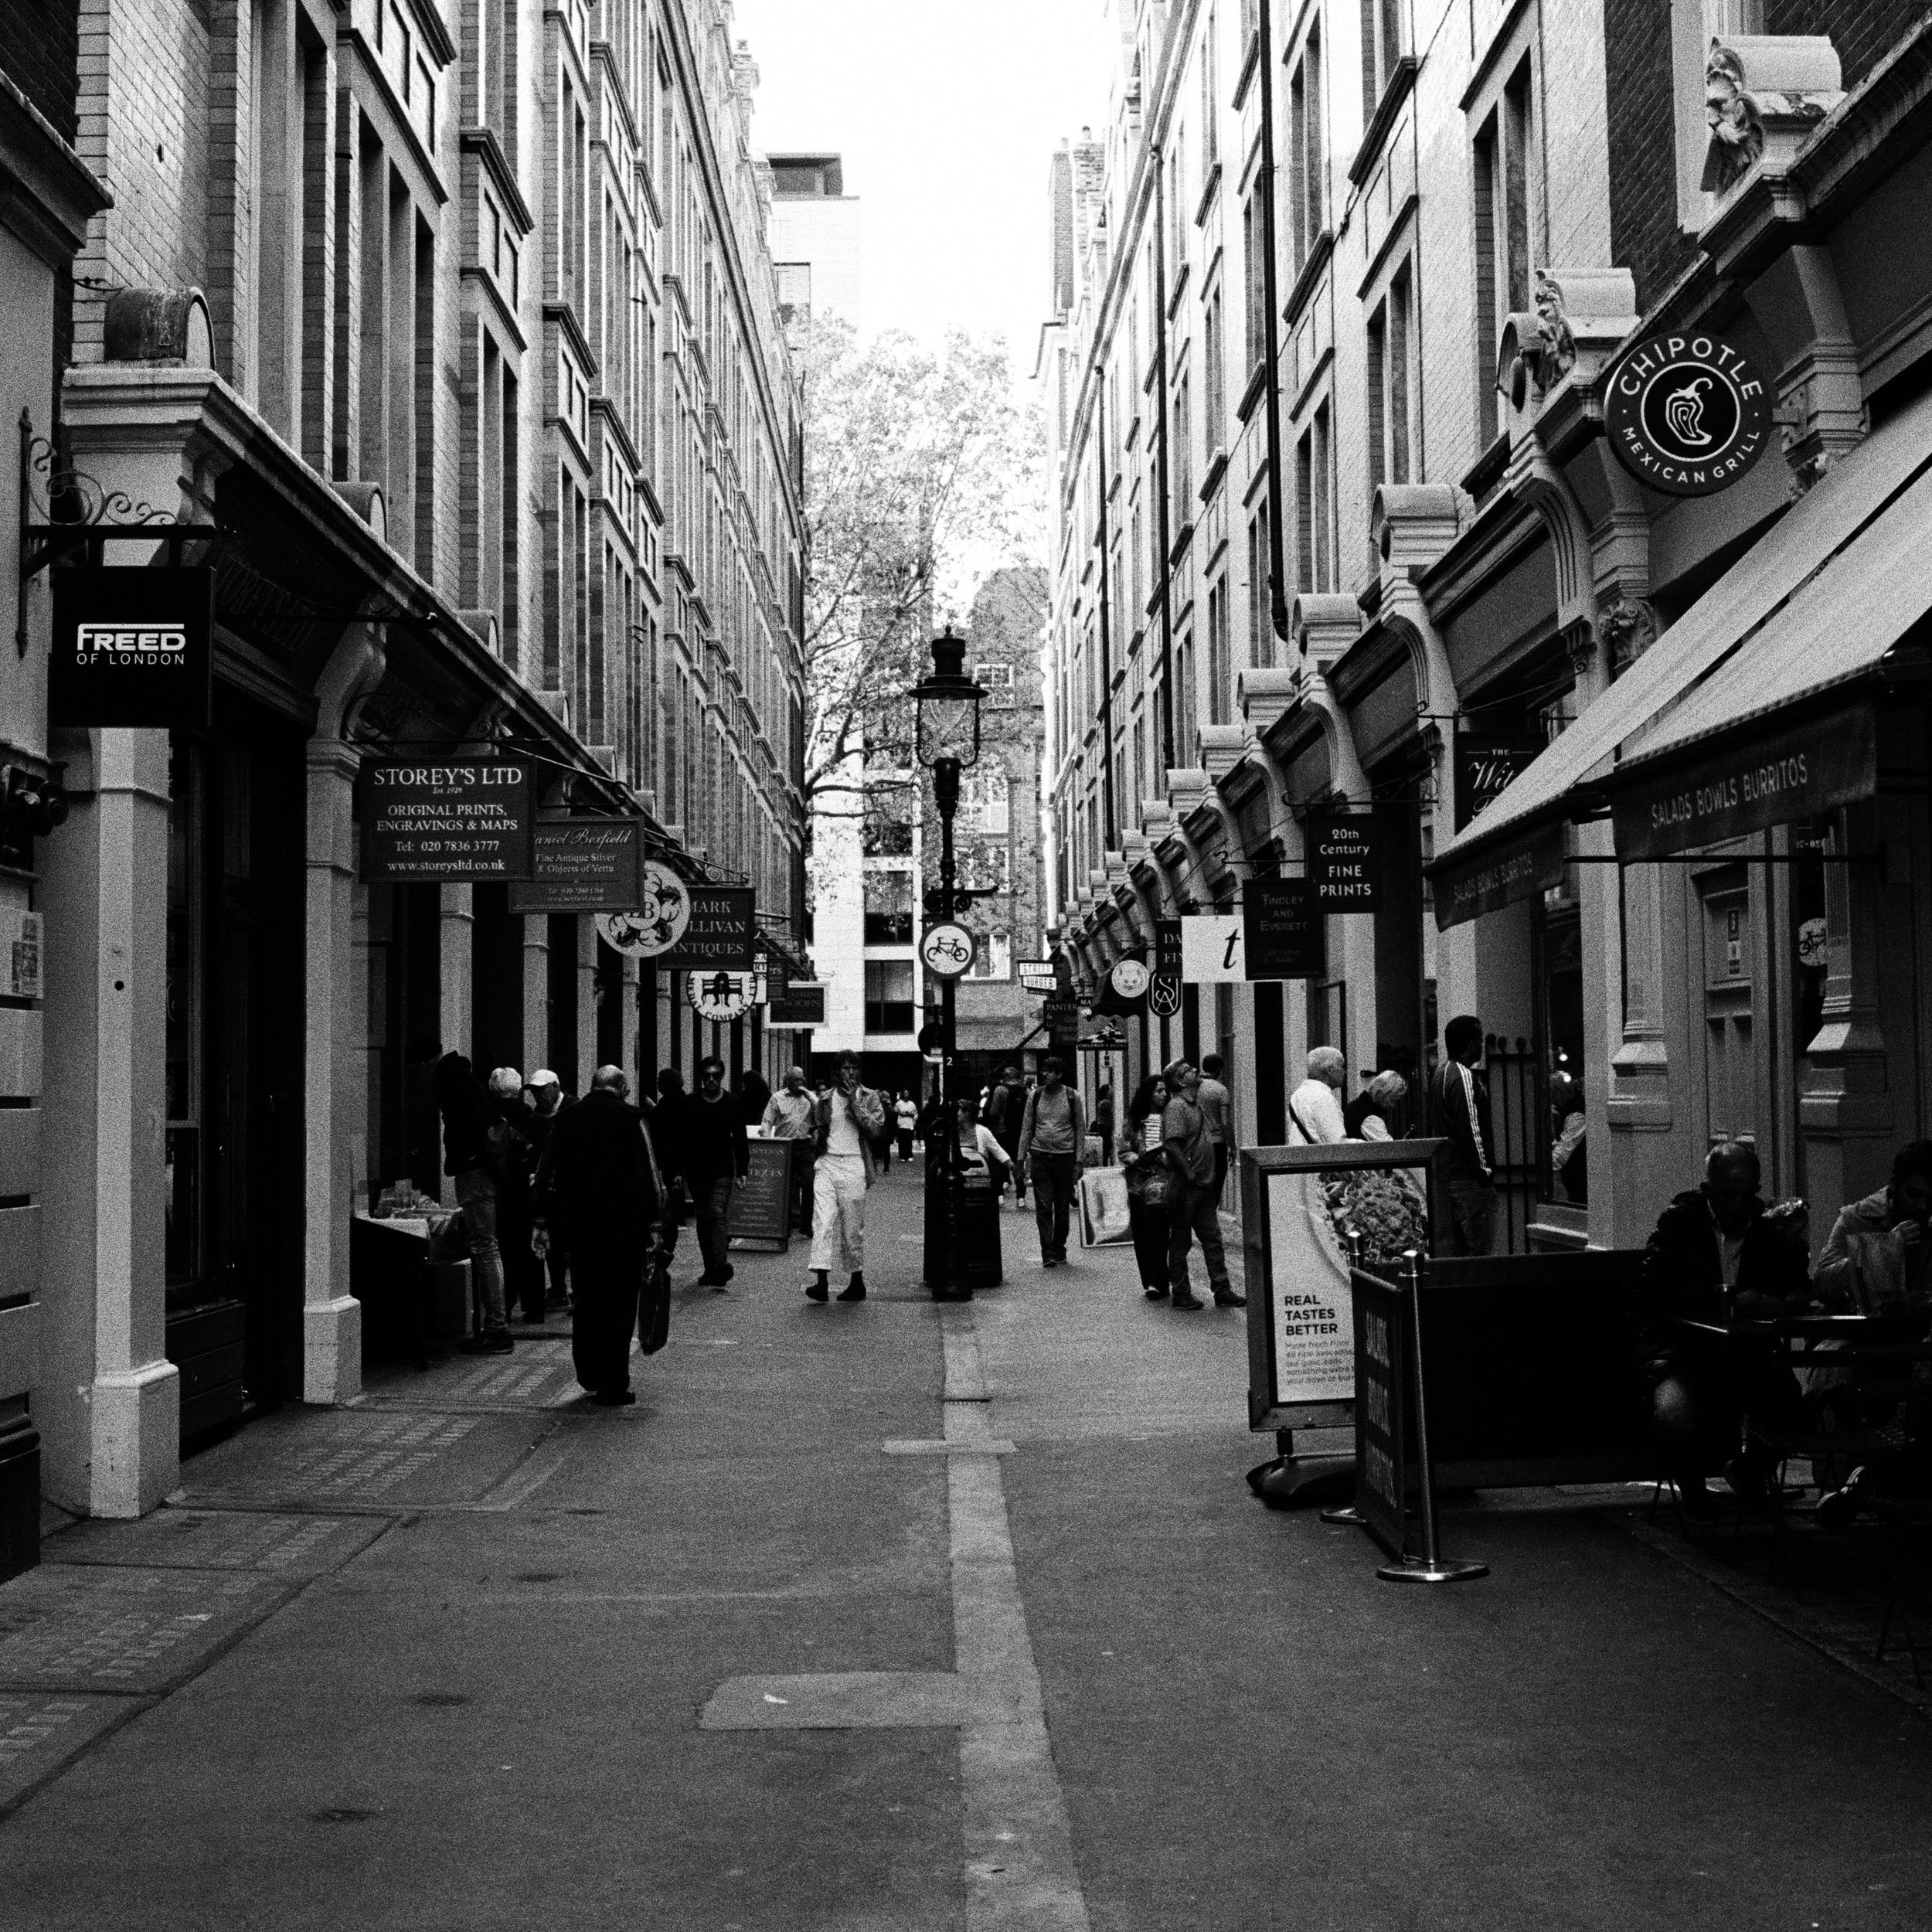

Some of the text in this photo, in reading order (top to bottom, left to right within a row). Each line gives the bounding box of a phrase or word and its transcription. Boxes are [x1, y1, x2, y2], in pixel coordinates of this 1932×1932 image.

[1620, 338, 1764, 401] CHIPOTLE
[1623, 427, 1760, 483] MEXICAN GRILL
[77, 623, 185, 651] FREED
[77, 653, 185, 665] OF LONDON
[374, 768, 522, 785] STOREY'S LTD
[1468, 761, 1516, 789] Wit
[1651, 753, 1808, 828] SALADS BOWLS BURRITOS
[388, 804, 454, 816] ORIGINAL
[376, 820, 518, 832] ENGRAVINGS & MAPS
[533, 832, 570, 845] aniel
[1332, 828, 1359, 840] 20th
[395, 841, 500, 852] Tel: 020 7836 3777
[1319, 842, 1370, 855] Century
[556, 854, 589, 864] Antique
[387, 859, 505, 873] www.storeysltd.co.uk
[547, 865, 579, 875] Objects
[1328, 865, 1362, 877] FINE
[1319, 883, 1372, 896] PRINTS
[1272, 909, 1294, 918] AND
[689, 920, 746, 933] LLIVAN
[1022, 964, 1050, 974] STREET
[1026, 977, 1055, 988] BURGER
[705, 1003, 749, 1022] COMPANY
[946, 1056, 953, 1066] 2
[1284, 1294, 1321, 1306] REAL
[1285, 1308, 1335, 1321] TASTES
[1286, 1323, 1338, 1336] BETTER
